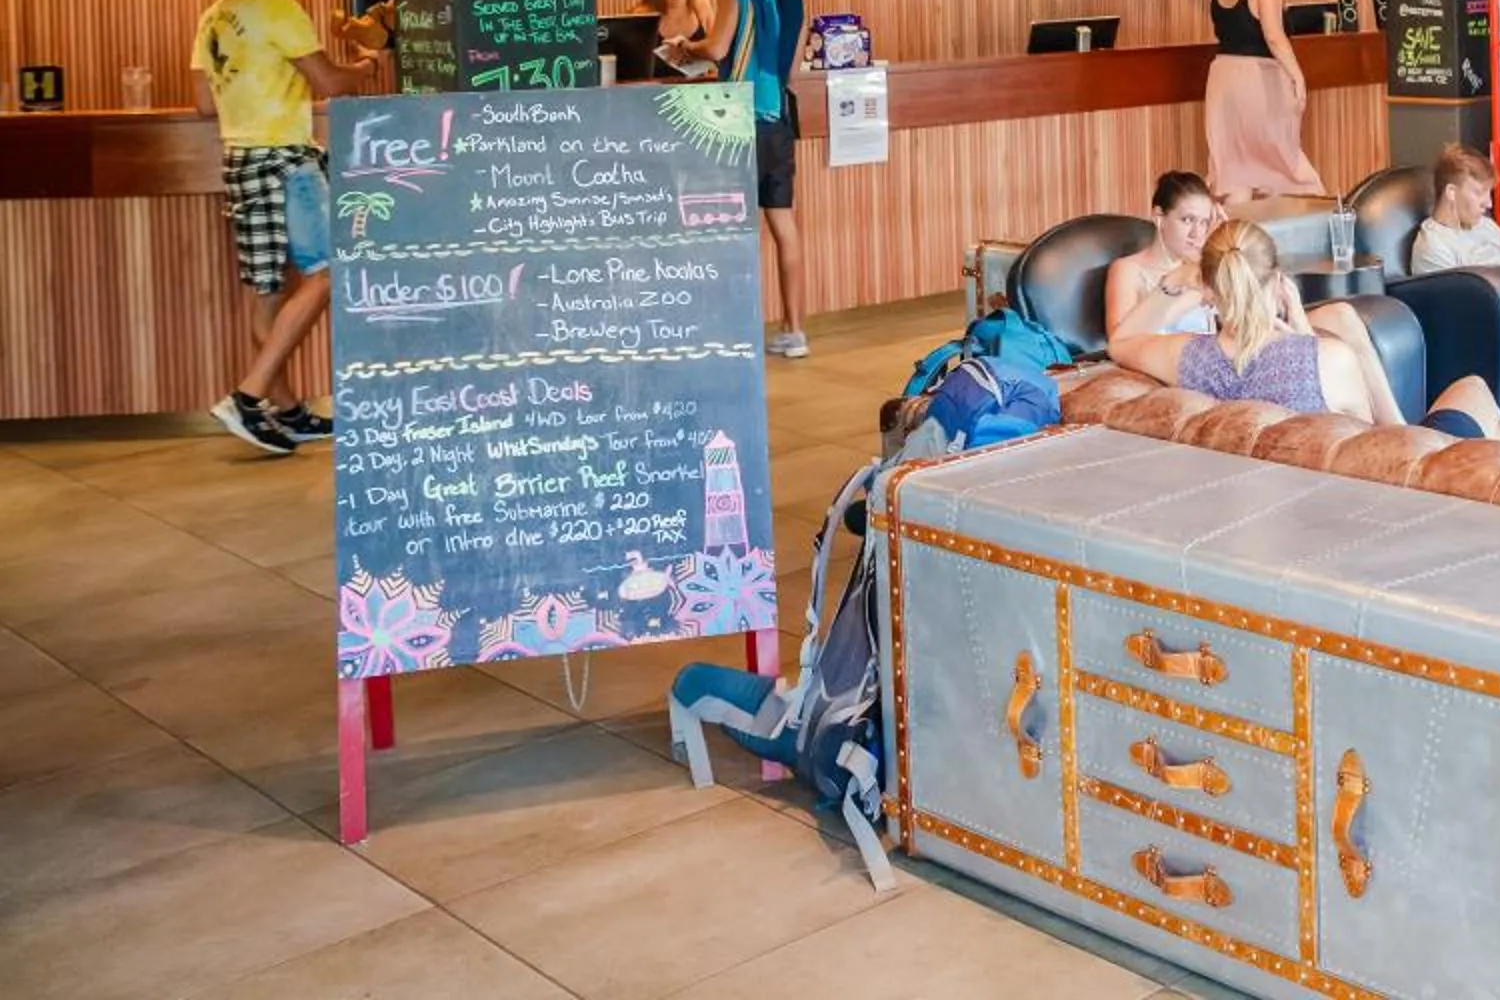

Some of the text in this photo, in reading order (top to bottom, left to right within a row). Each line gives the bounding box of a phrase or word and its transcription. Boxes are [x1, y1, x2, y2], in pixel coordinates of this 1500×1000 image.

[466, 133, 685, 153] Parkland on the river
[605, 257, 650, 283] Pine
[344, 267, 431, 308] Under
[646, 318, 700, 340] Tour
[335, 386, 403, 430] Sexy
[527, 376, 594, 405] Deals
[364, 427, 399, 448] Day
[525, 411, 567, 427] 4WD
[364, 486, 410, 511] Day
[422, 473, 479, 502] Great
[576, 459, 630, 490] Reef
[405, 537, 433, 555] or
[651, 528, 688, 545] TAX
